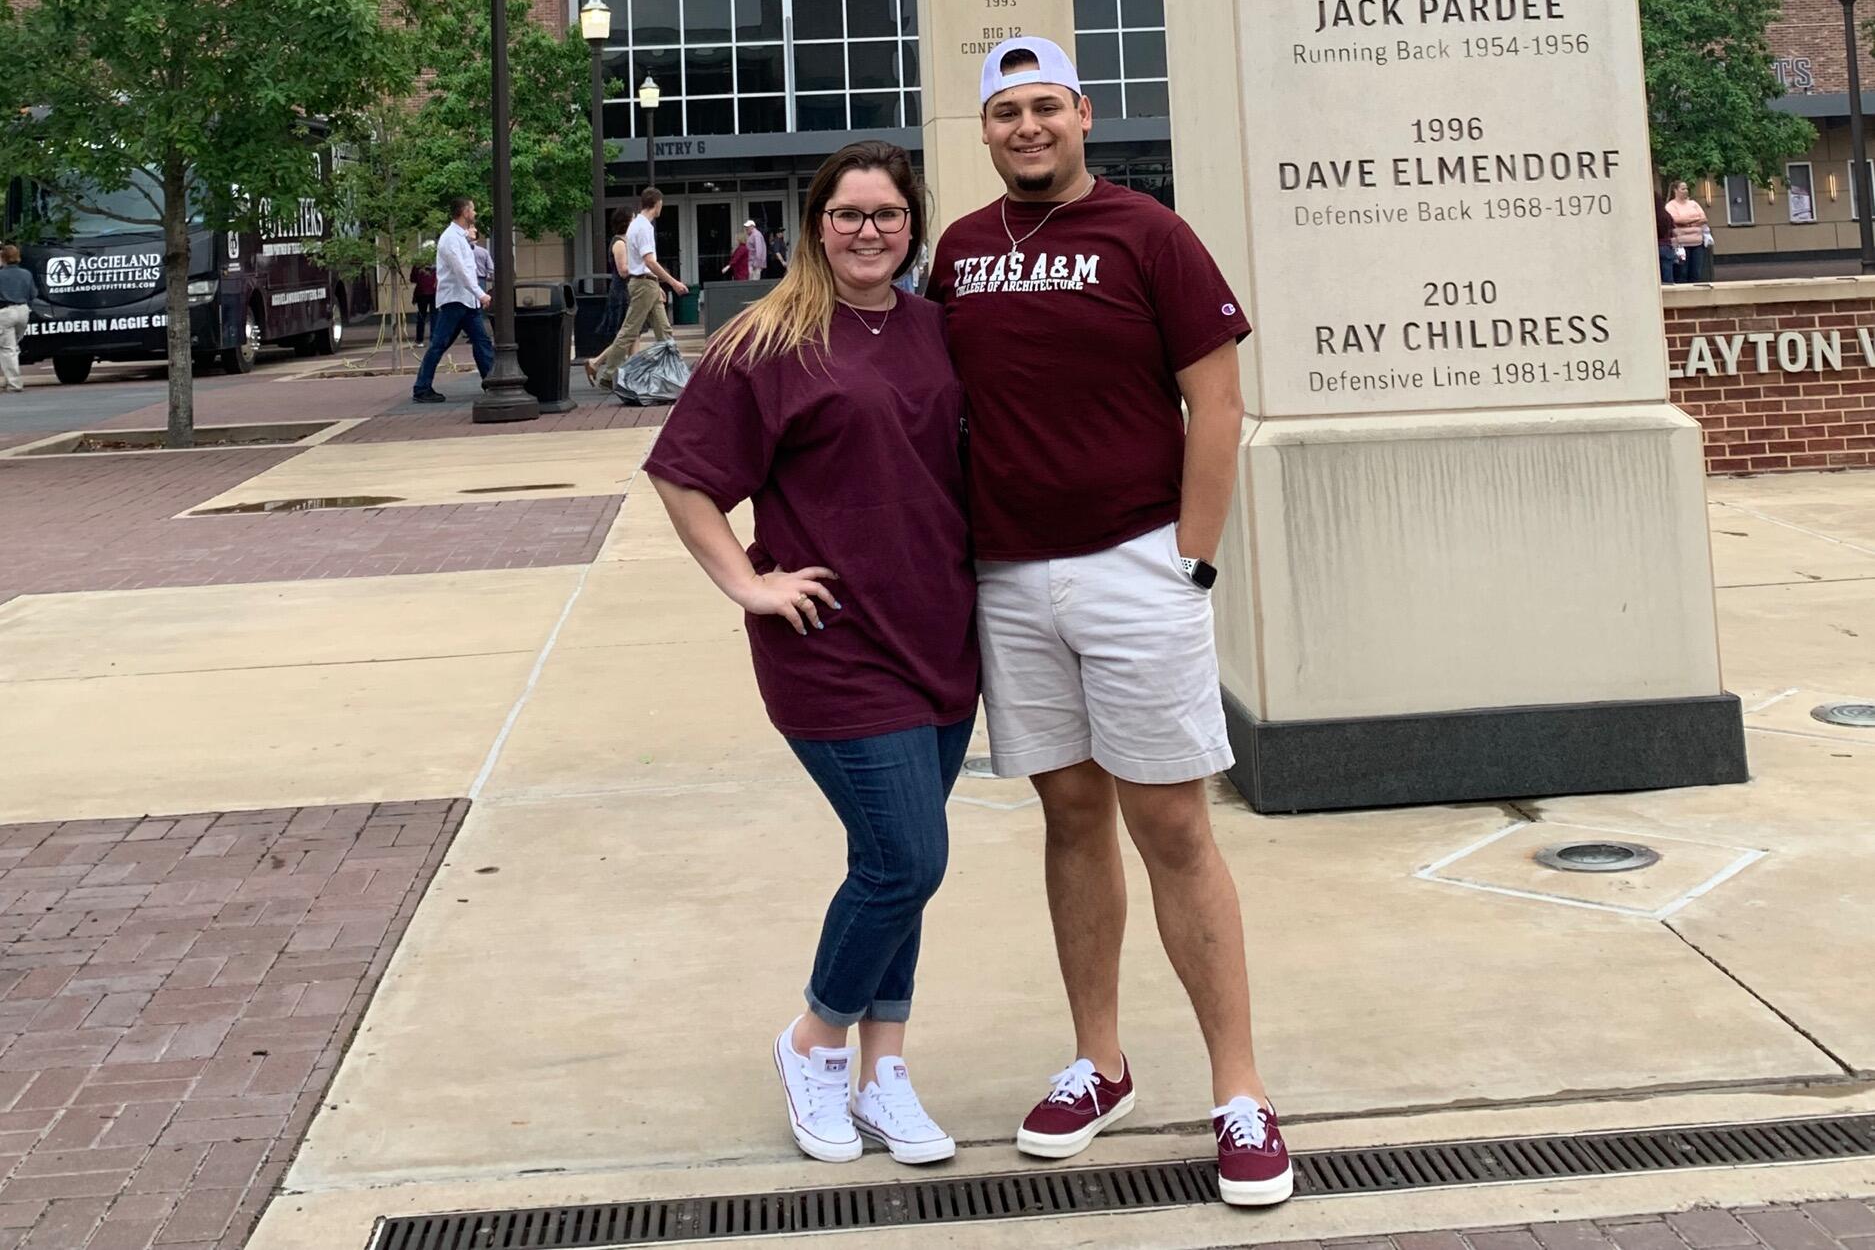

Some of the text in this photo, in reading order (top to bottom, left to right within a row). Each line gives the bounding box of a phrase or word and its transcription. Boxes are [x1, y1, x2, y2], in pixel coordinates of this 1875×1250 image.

[983, 26, 1022, 39] BIG 12
[1293, 34, 1589, 66] Running Back 1954-1956
[1411, 117, 1484, 144] 1996
[648, 141, 692, 156] NTRY
[1278, 150, 1621, 192] DAVE ELMENDORF
[1294, 194, 1612, 227] Defensive Back 1968-1970
[77, 253, 161, 270] AGGIELAND
[953, 252, 1100, 288] TEXAS A&M
[49, 281, 156, 294] AGGIELANDOUTFITTERS.COM
[76, 267, 161, 284] OUTFITTERS
[956, 279, 1085, 298] COLLEGE OF ARCHITECTURE
[1423, 280, 1497, 306] 2010
[41, 320, 90, 334] LEADER
[93, 319, 107, 332] IN
[109, 315, 150, 331] AGGIE
[1315, 314, 1610, 356] RAY CHILDRESS
[1308, 359, 1622, 393] Defensive Line 1981-1984
